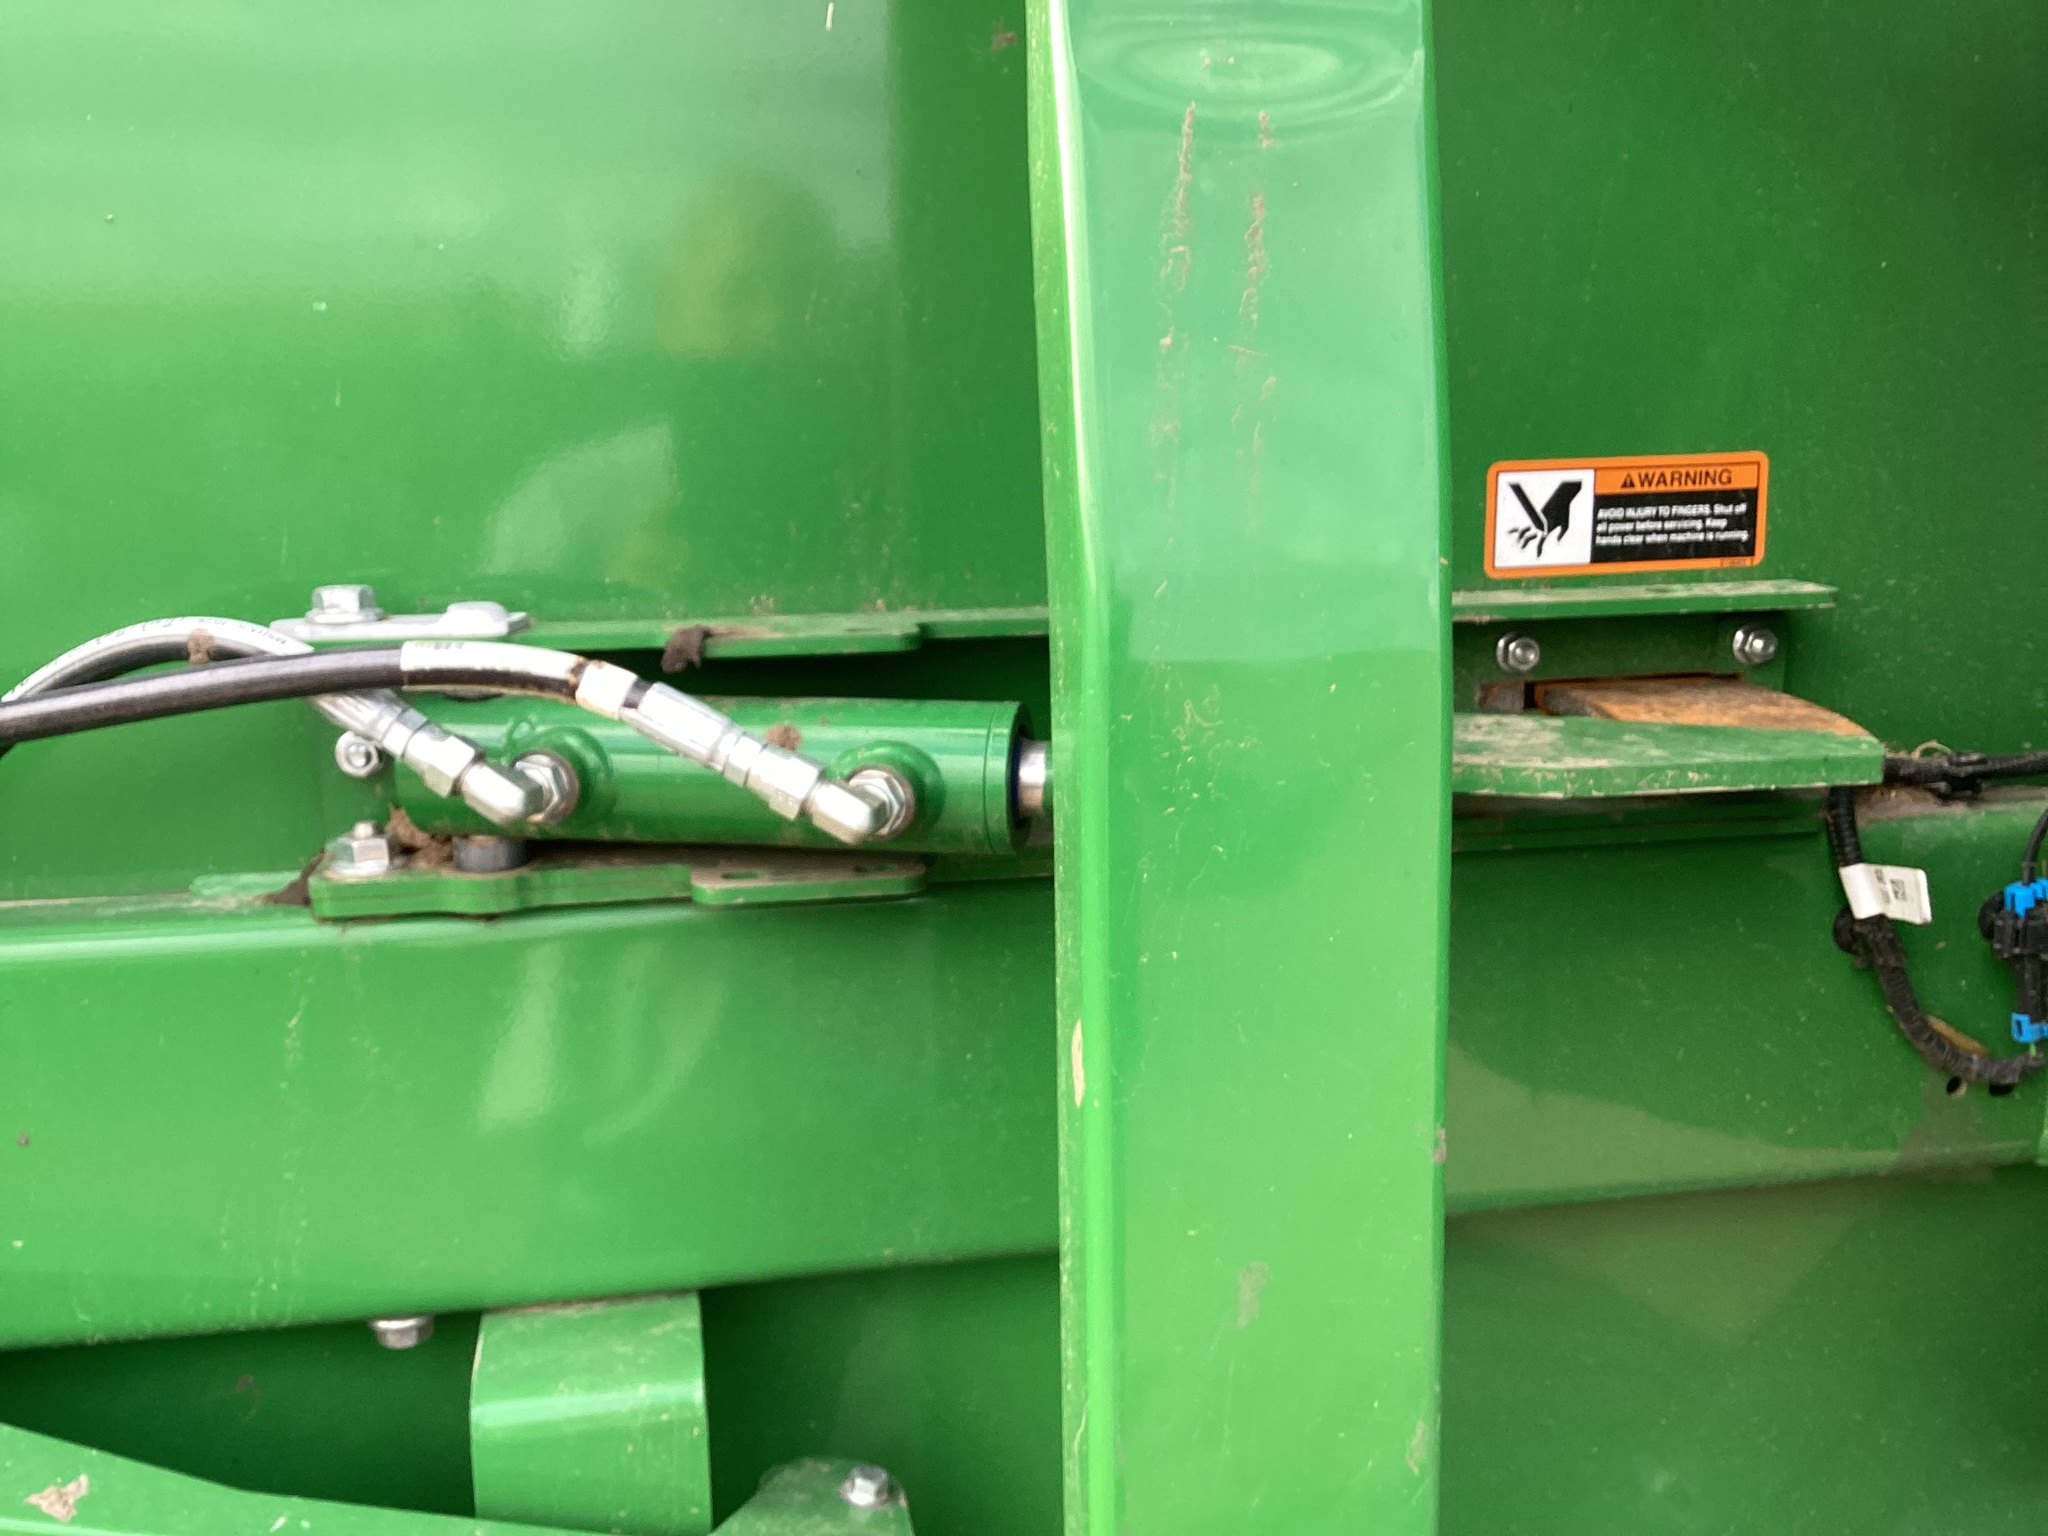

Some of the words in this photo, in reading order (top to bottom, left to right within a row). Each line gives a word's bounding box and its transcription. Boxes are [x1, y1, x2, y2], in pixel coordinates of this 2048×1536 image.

[1638, 468, 1732, 488] WARNING
[1597, 507, 1624, 519] AVOID
[1625, 506, 1657, 518] INJURY
[1658, 505, 1670, 517] TO
[1713, 503, 1733, 515] Shut
[1734, 502, 1747, 515] off
[1596, 522, 1607, 532] all
[1608, 521, 1634, 533] power
[1635, 520, 1662, 531] before
[1705, 517, 1728, 529] Keep
[1595, 534, 1621, 545] hands
[1623, 534, 1643, 544] clear
[1645, 533, 1668, 543] when
[1669, 532, 1704, 542] machine
[1705, 531, 1714, 541] is
